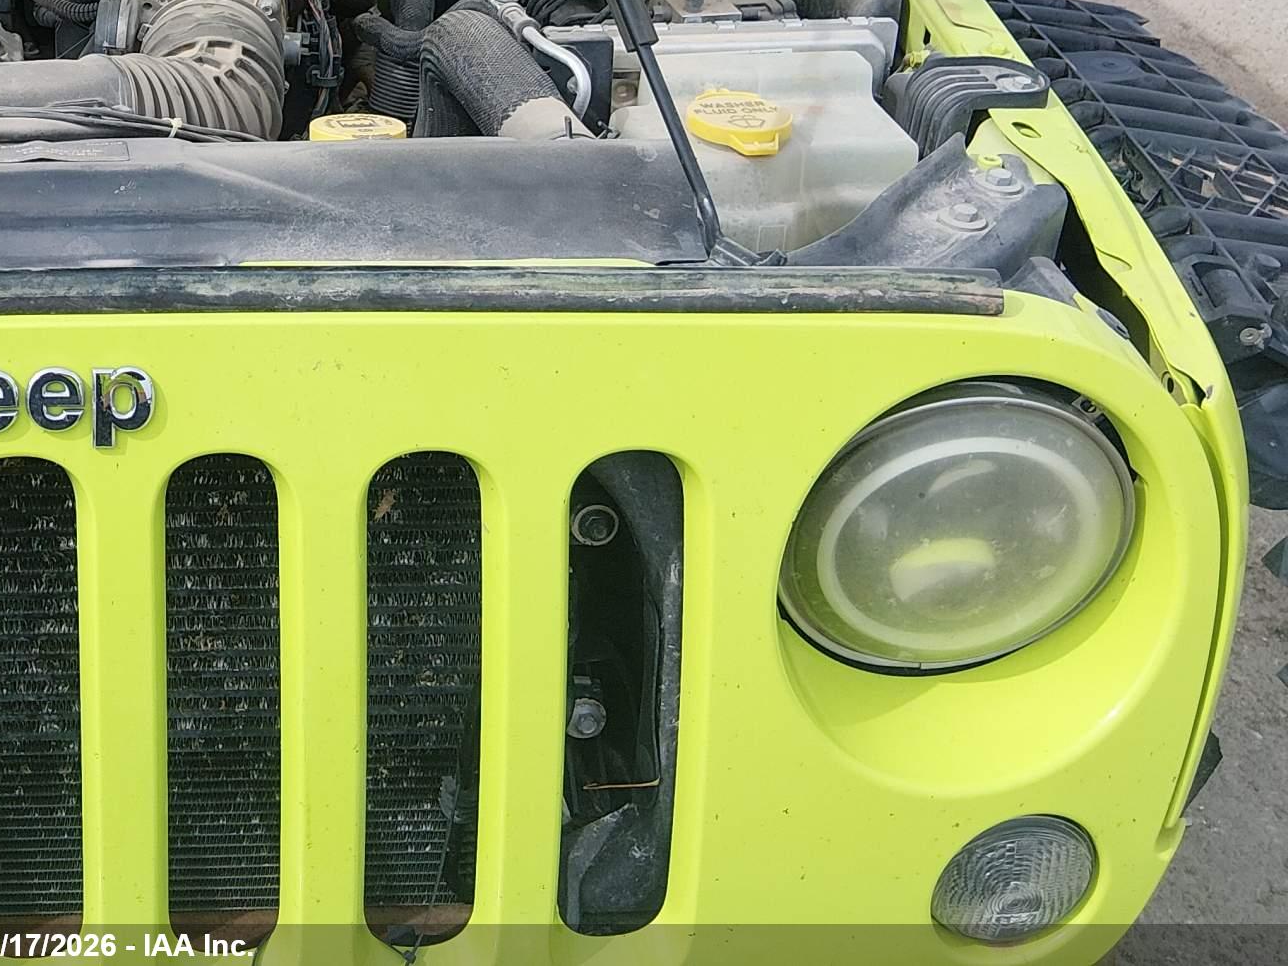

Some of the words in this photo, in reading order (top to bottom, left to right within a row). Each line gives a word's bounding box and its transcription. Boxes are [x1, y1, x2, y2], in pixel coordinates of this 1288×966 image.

[699, 100, 765, 109] WASHER
[693, 107, 738, 115] FLUID
[741, 106, 778, 114] ONLY
